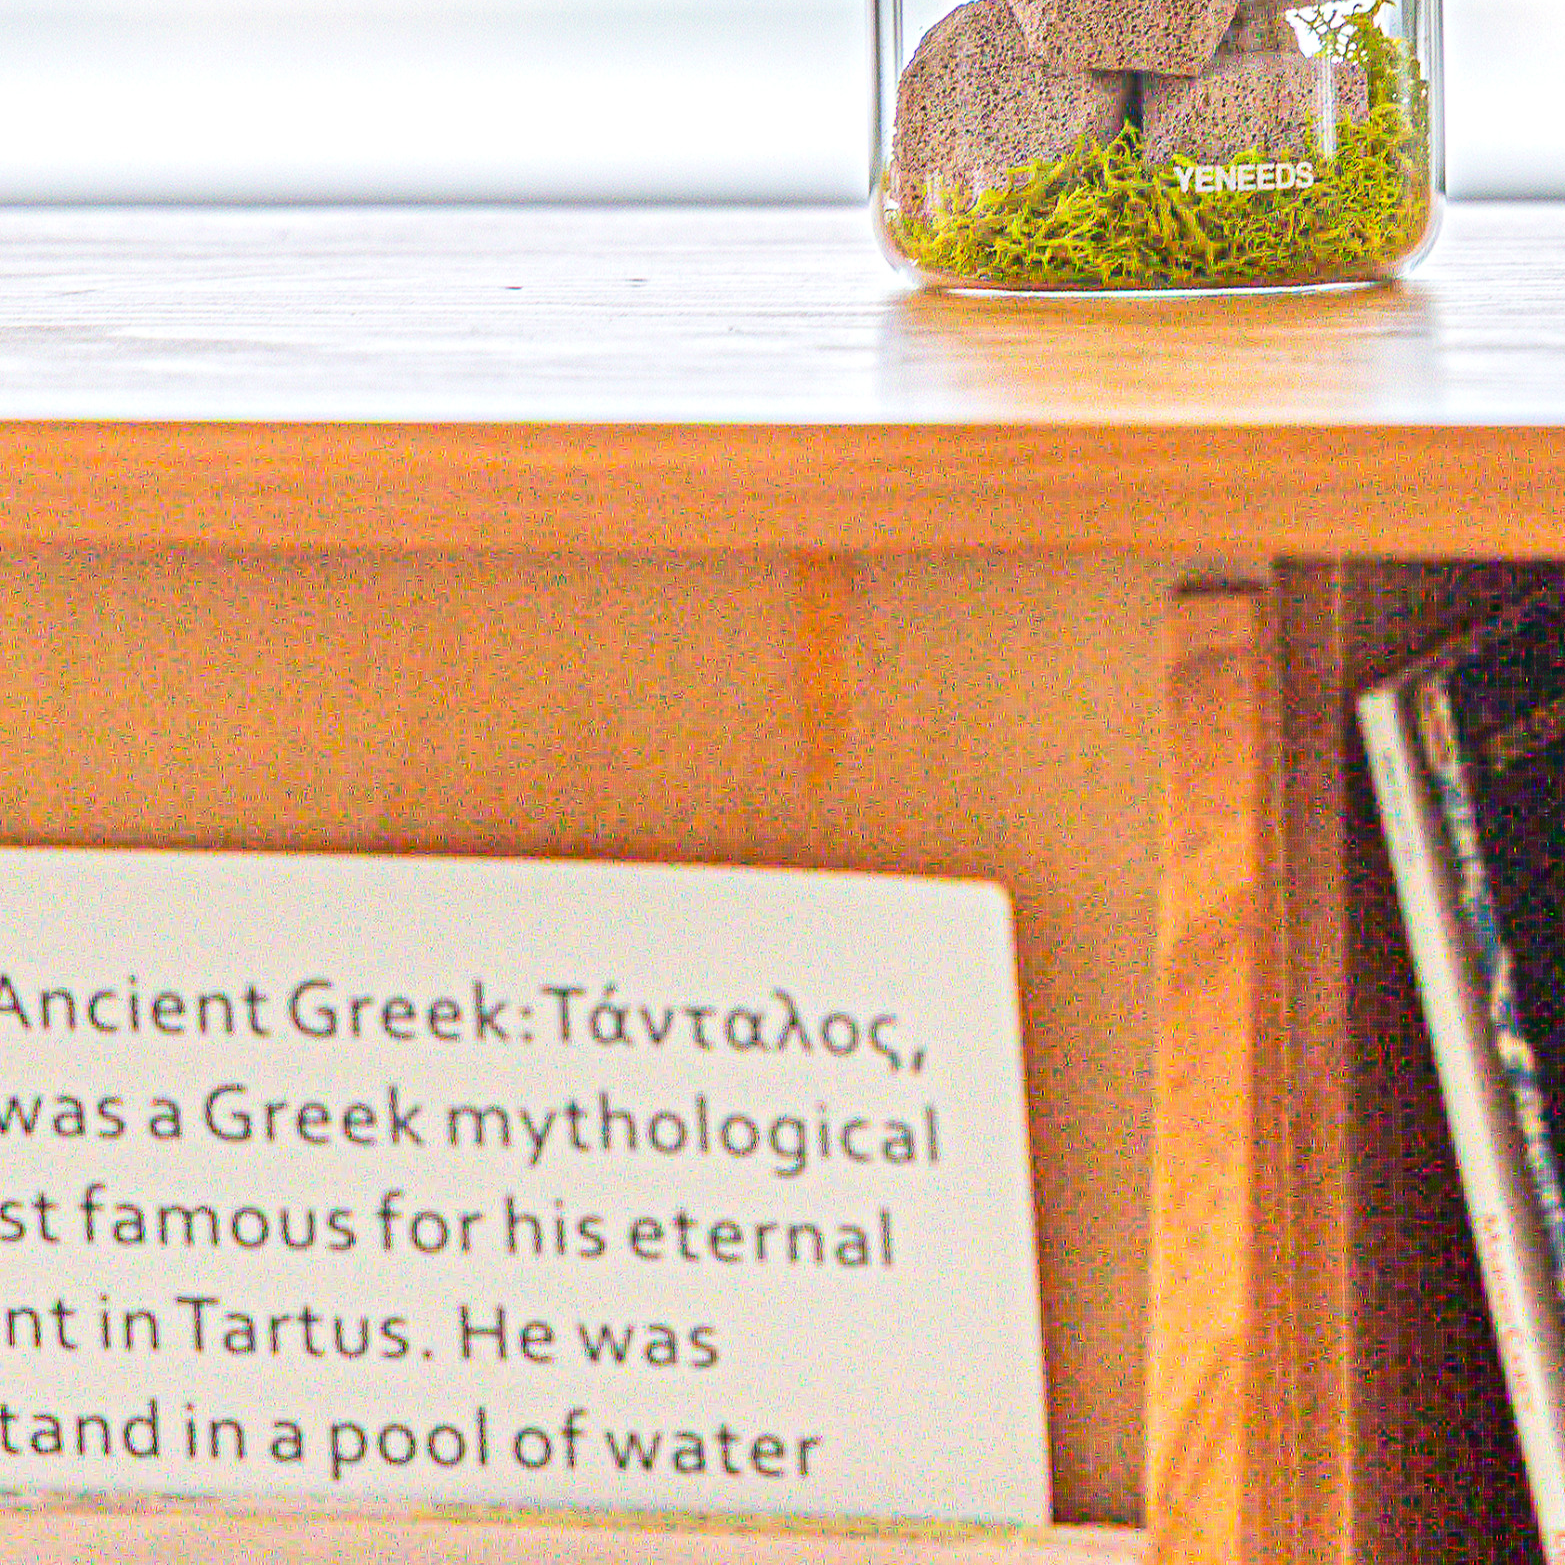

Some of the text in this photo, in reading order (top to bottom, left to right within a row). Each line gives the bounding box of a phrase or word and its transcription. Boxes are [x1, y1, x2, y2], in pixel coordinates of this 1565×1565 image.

[1173, 161, 1315, 193] YENEEDS
[0, 972, 270, 1036] Ancient
[0, 1083, 938, 1177] was a Greek mythological
[80, 1182, 358, 1251] famous
[377, 1190, 483, 1255] for
[504, 1196, 607, 1258] his
[628, 1207, 896, 1270] eternal
[100, 1292, 160, 1352] in
[176, 1295, 434, 1362] Tartus.
[459, 1306, 556, 1363] He
[576, 1324, 720, 1369] was
[184, 1402, 246, 1459] in
[269, 1420, 305, 1462] a
[329, 1408, 489, 1481] pool
[512, 1407, 588, 1471] of
[605, 1427, 822, 1479] water
